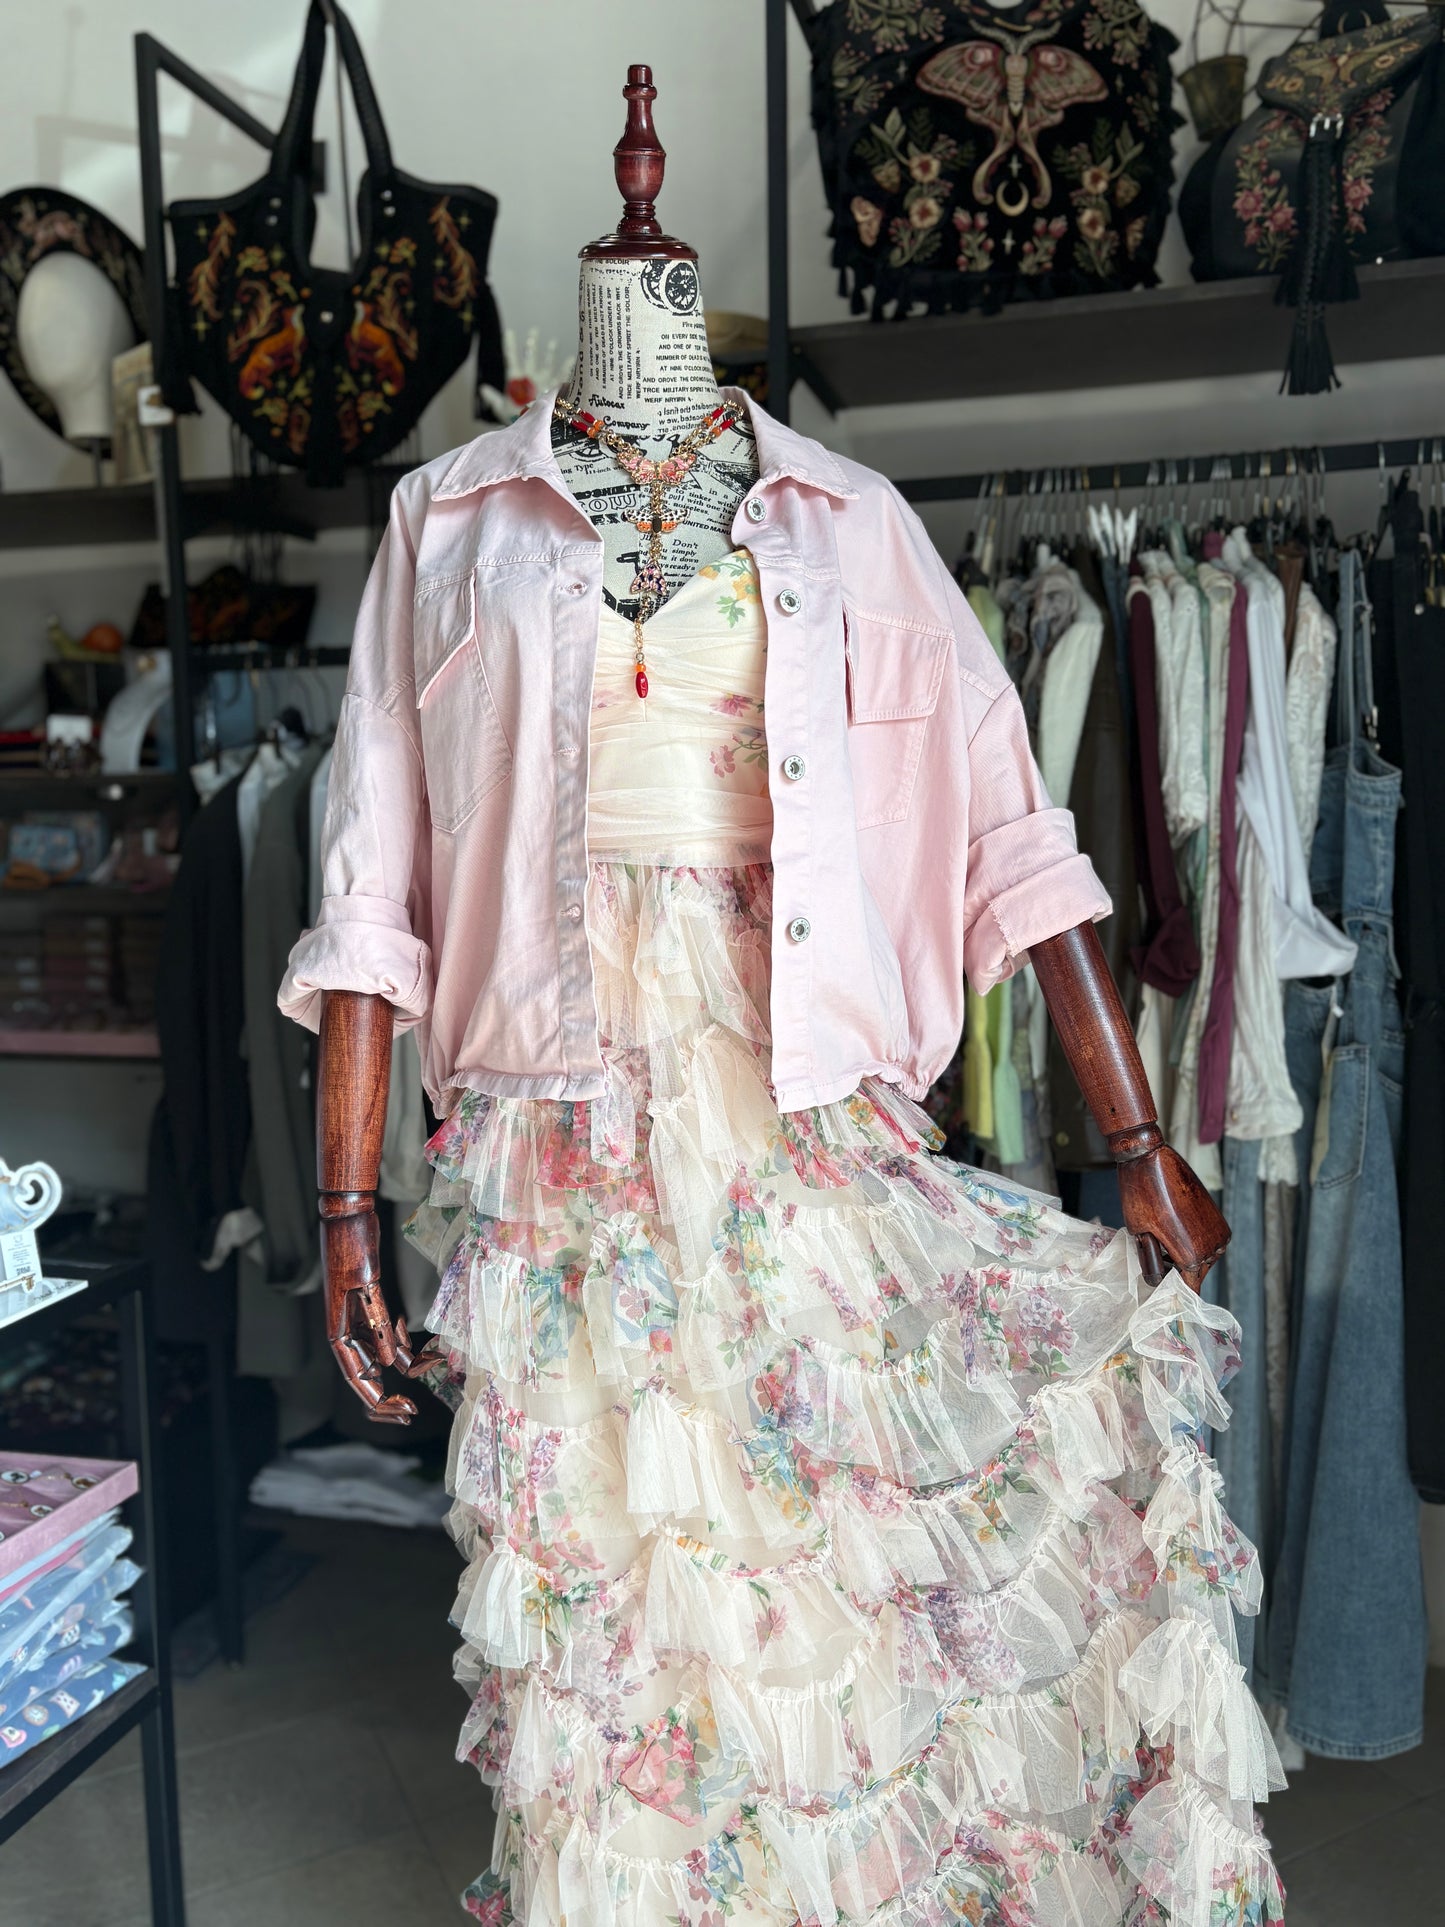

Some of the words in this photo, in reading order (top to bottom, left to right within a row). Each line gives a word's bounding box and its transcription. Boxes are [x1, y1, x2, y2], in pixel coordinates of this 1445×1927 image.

[603, 416, 650, 431] Company
[574, 464, 594, 475] Type
[689, 492, 712, 502] tinker
[709, 488, 718, 496] in
[669, 494, 685, 502] pull
[688, 498, 704, 507] with
[683, 520, 710, 530] UNITED
[673, 539, 699, 550] Don't
[672, 549, 697, 557] simply
